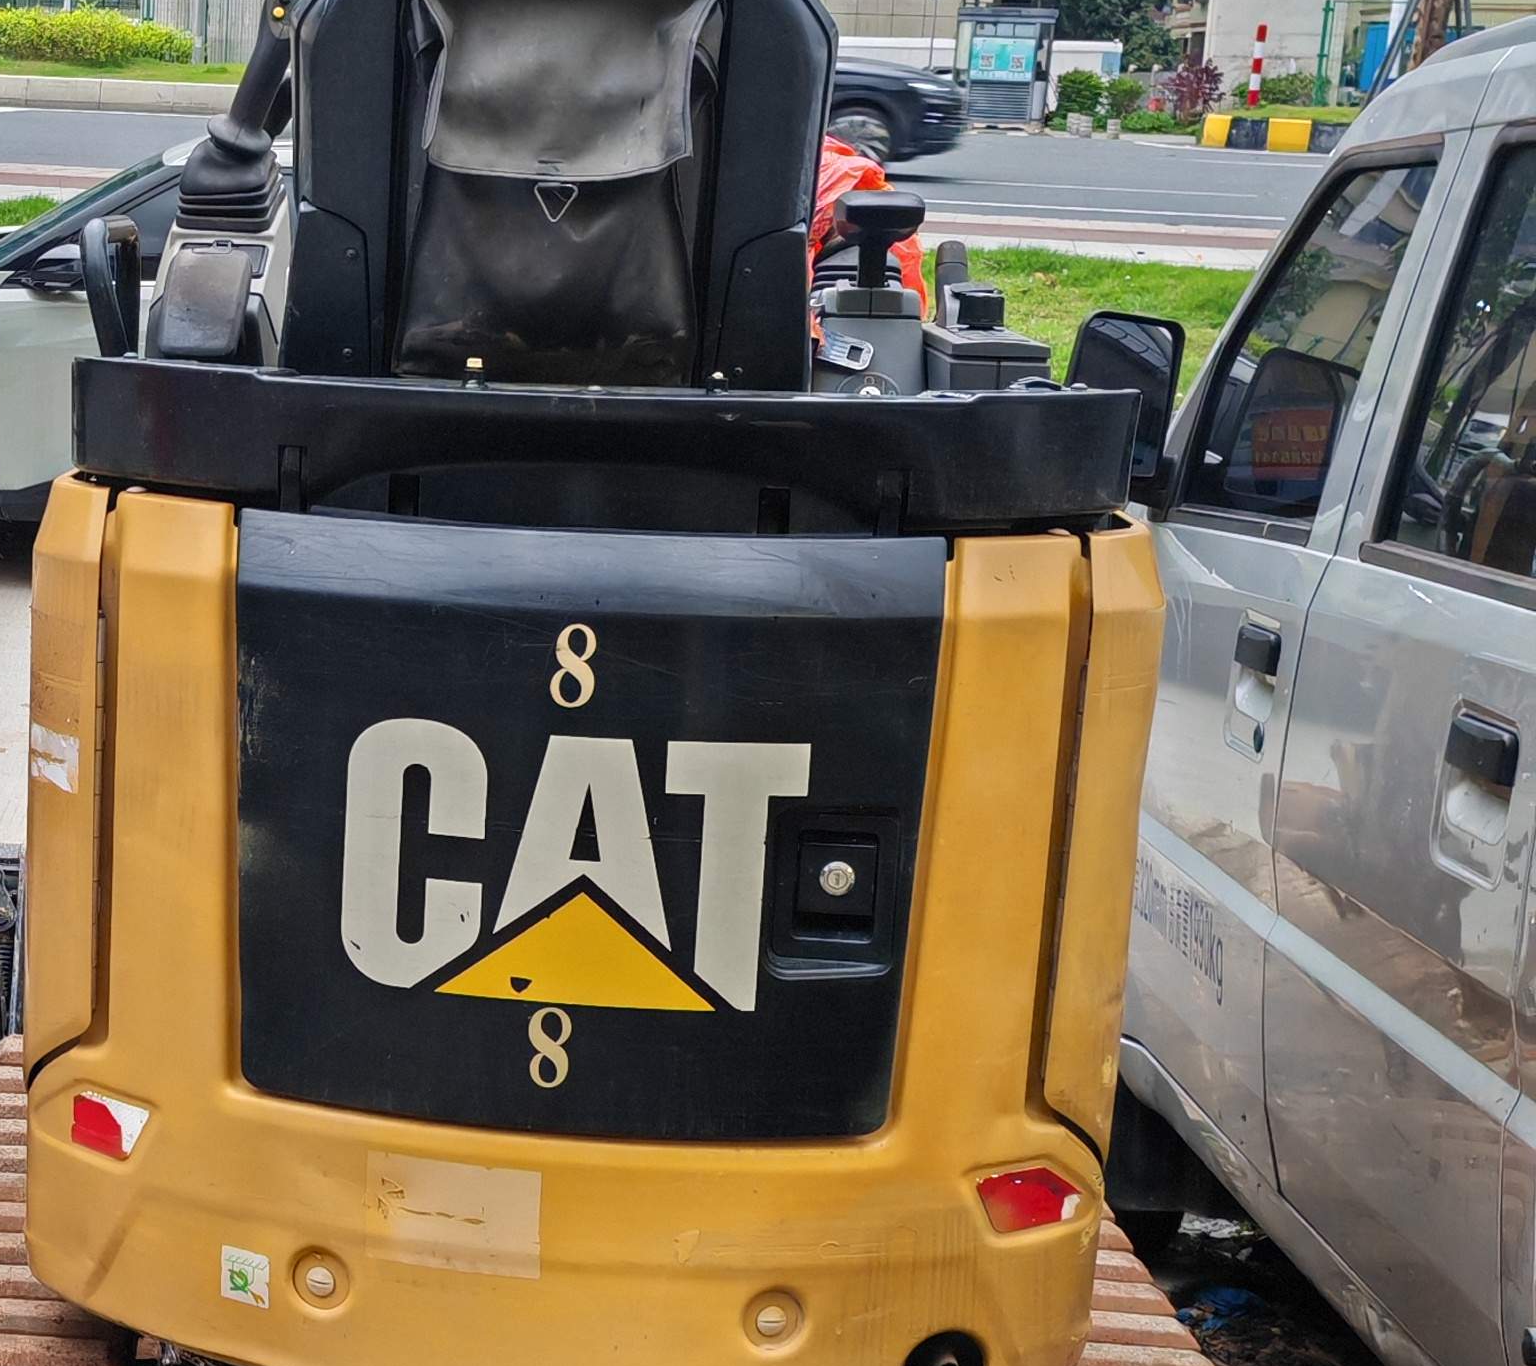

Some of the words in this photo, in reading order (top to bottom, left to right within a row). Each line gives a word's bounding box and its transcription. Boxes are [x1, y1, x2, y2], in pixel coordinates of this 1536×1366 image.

[549, 623, 597, 708] 8
[341, 718, 811, 1011] CAT
[528, 1007, 572, 1088] 8
